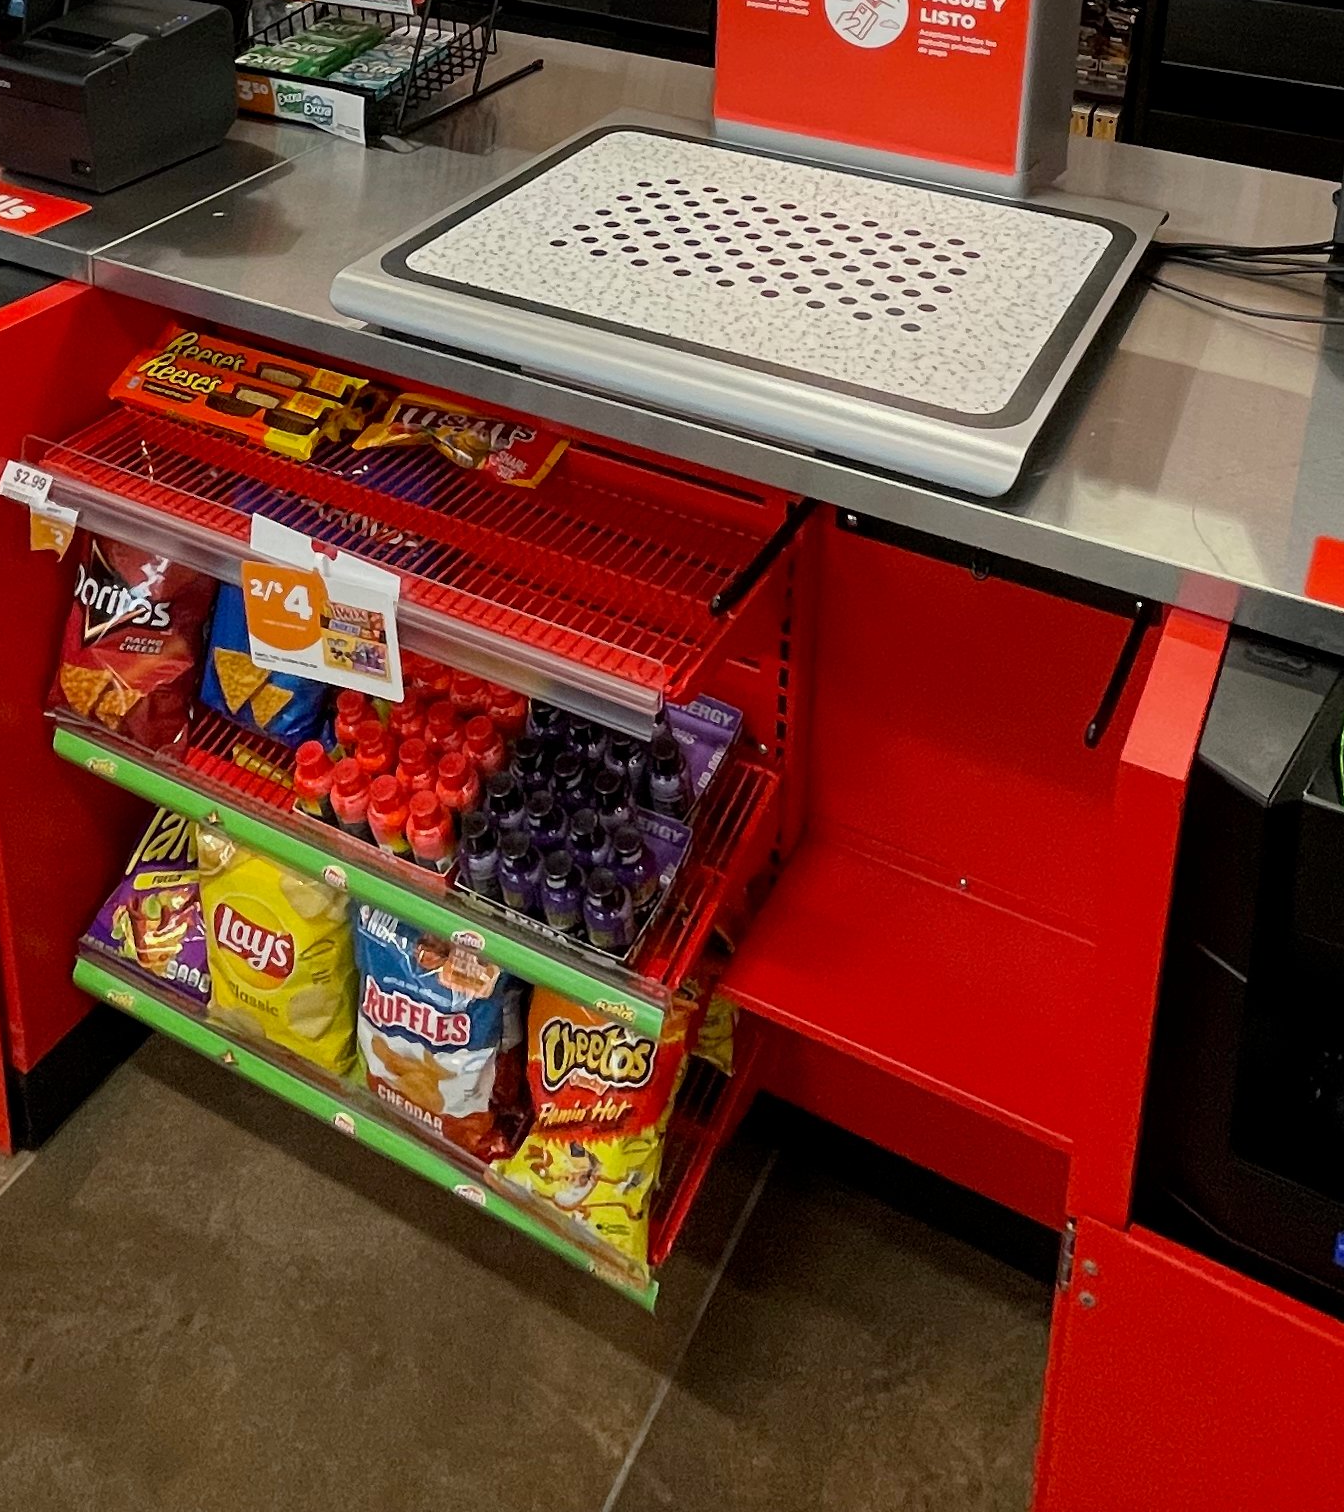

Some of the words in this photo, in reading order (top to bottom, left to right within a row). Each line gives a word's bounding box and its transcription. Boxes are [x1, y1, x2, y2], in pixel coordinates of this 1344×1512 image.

[919, 7, 976, 30] LISTO
[136, 352, 223, 394] Reese's
[13, 467, 47, 491] $2.99
[119, 644, 163, 655] CHEESE
[124, 635, 164, 647] NACHO
[686, 700, 735, 728] ERGY
[217, 905, 292, 971] Lay's
[362, 980, 471, 1044] RUFFLES
[542, 1021, 654, 1086] Cheetos
[377, 1084, 444, 1131] CHEDDAR
[592, 1098, 633, 1122] Hot
